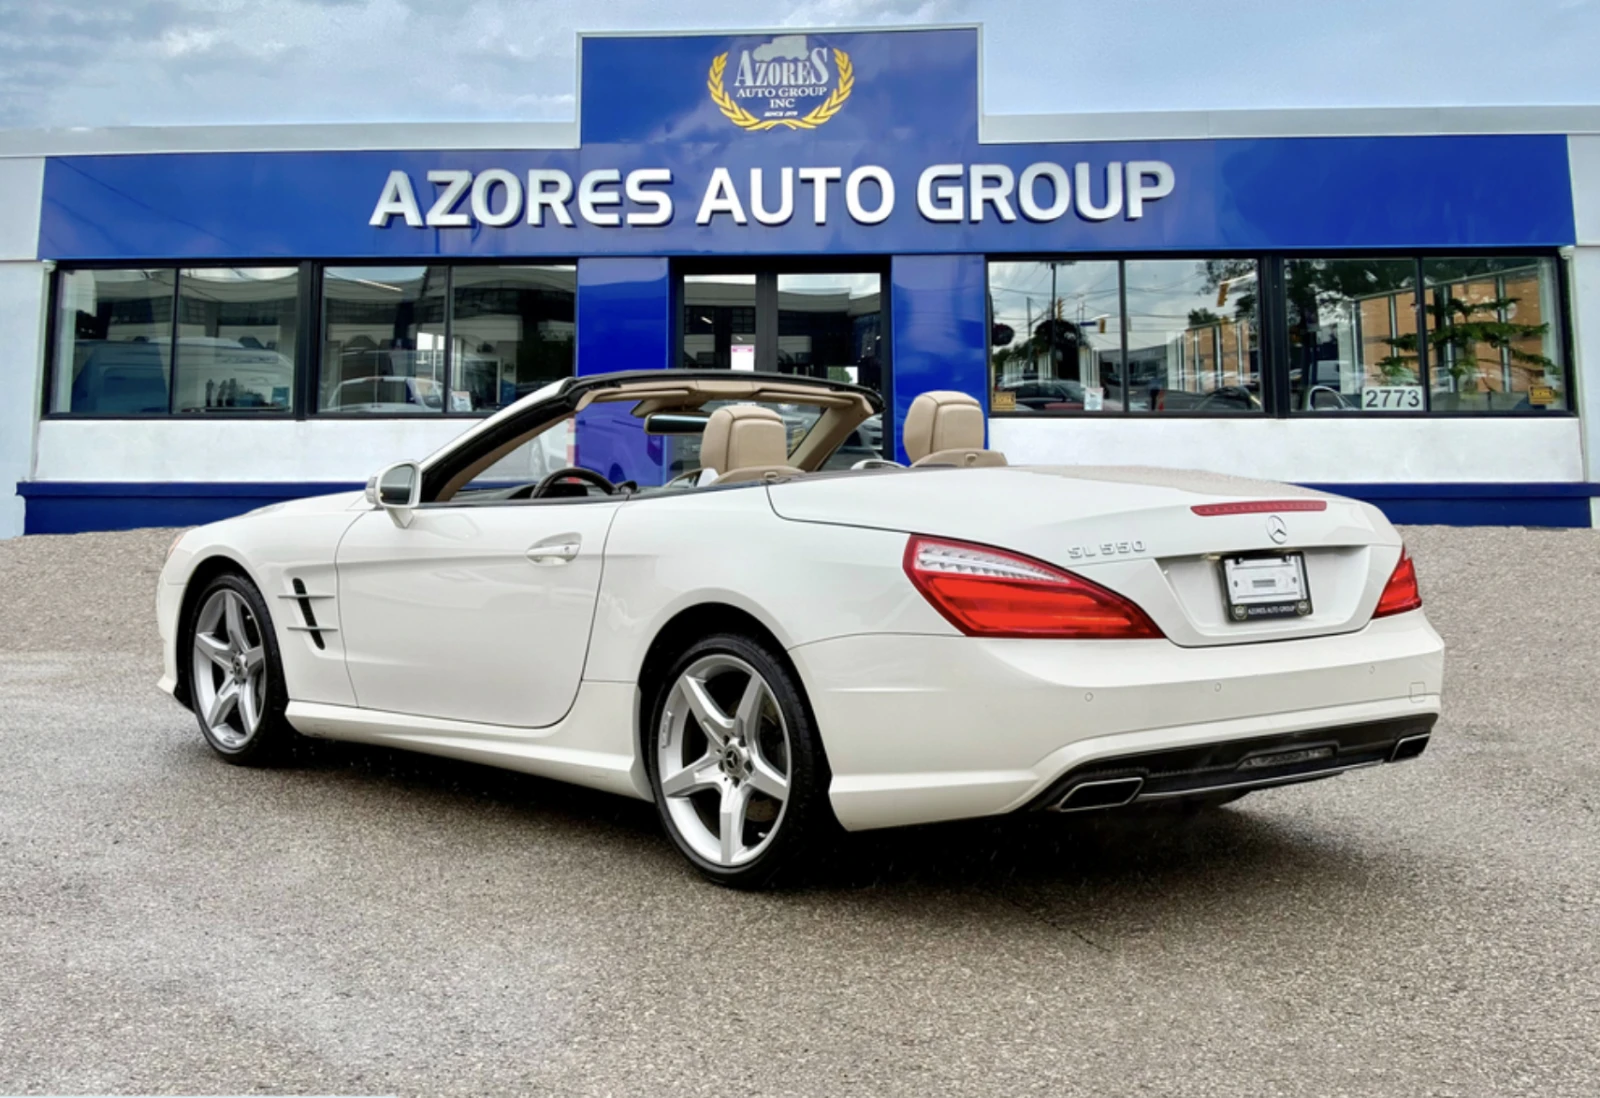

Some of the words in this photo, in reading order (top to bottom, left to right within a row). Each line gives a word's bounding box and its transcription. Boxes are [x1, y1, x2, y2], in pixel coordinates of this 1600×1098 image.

[736, 87, 776, 98] AUTO
[778, 87, 828, 97] GROUP
[769, 98, 796, 109] INC
[368, 168, 675, 228] AZORES
[694, 165, 896, 226] AUTO
[916, 160, 1176, 222] GROUP
[1365, 389, 1421, 408] 2773
[1067, 545, 1097, 560] SL
[1099, 540, 1147, 556] 550
